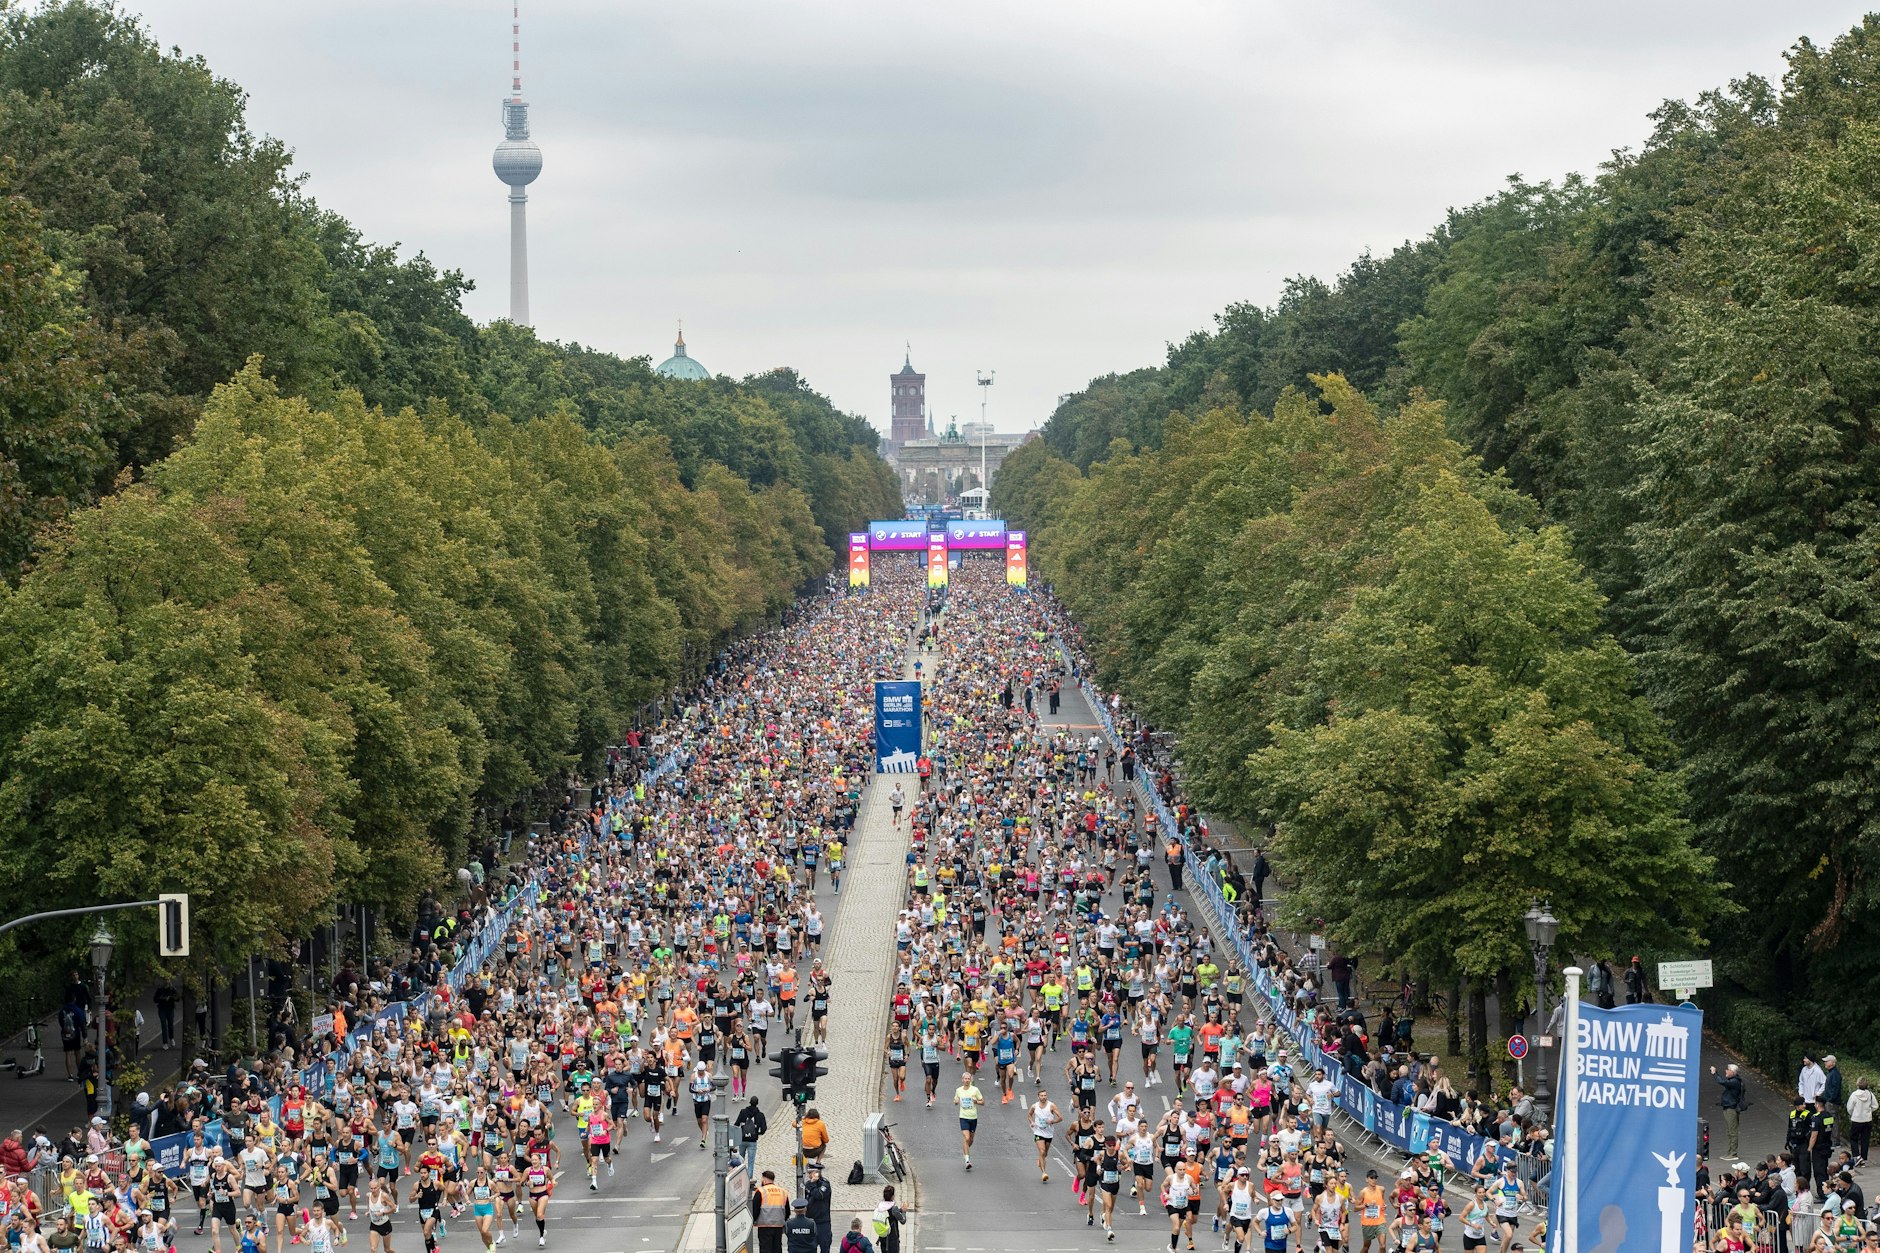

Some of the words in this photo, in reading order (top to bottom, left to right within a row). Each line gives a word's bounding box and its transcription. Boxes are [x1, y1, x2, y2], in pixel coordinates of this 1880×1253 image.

[901, 531, 922, 539] START
[979, 530, 1000, 538] START
[1577, 1019, 1642, 1052] BMW
[161, 1148, 173, 1158] BMW
